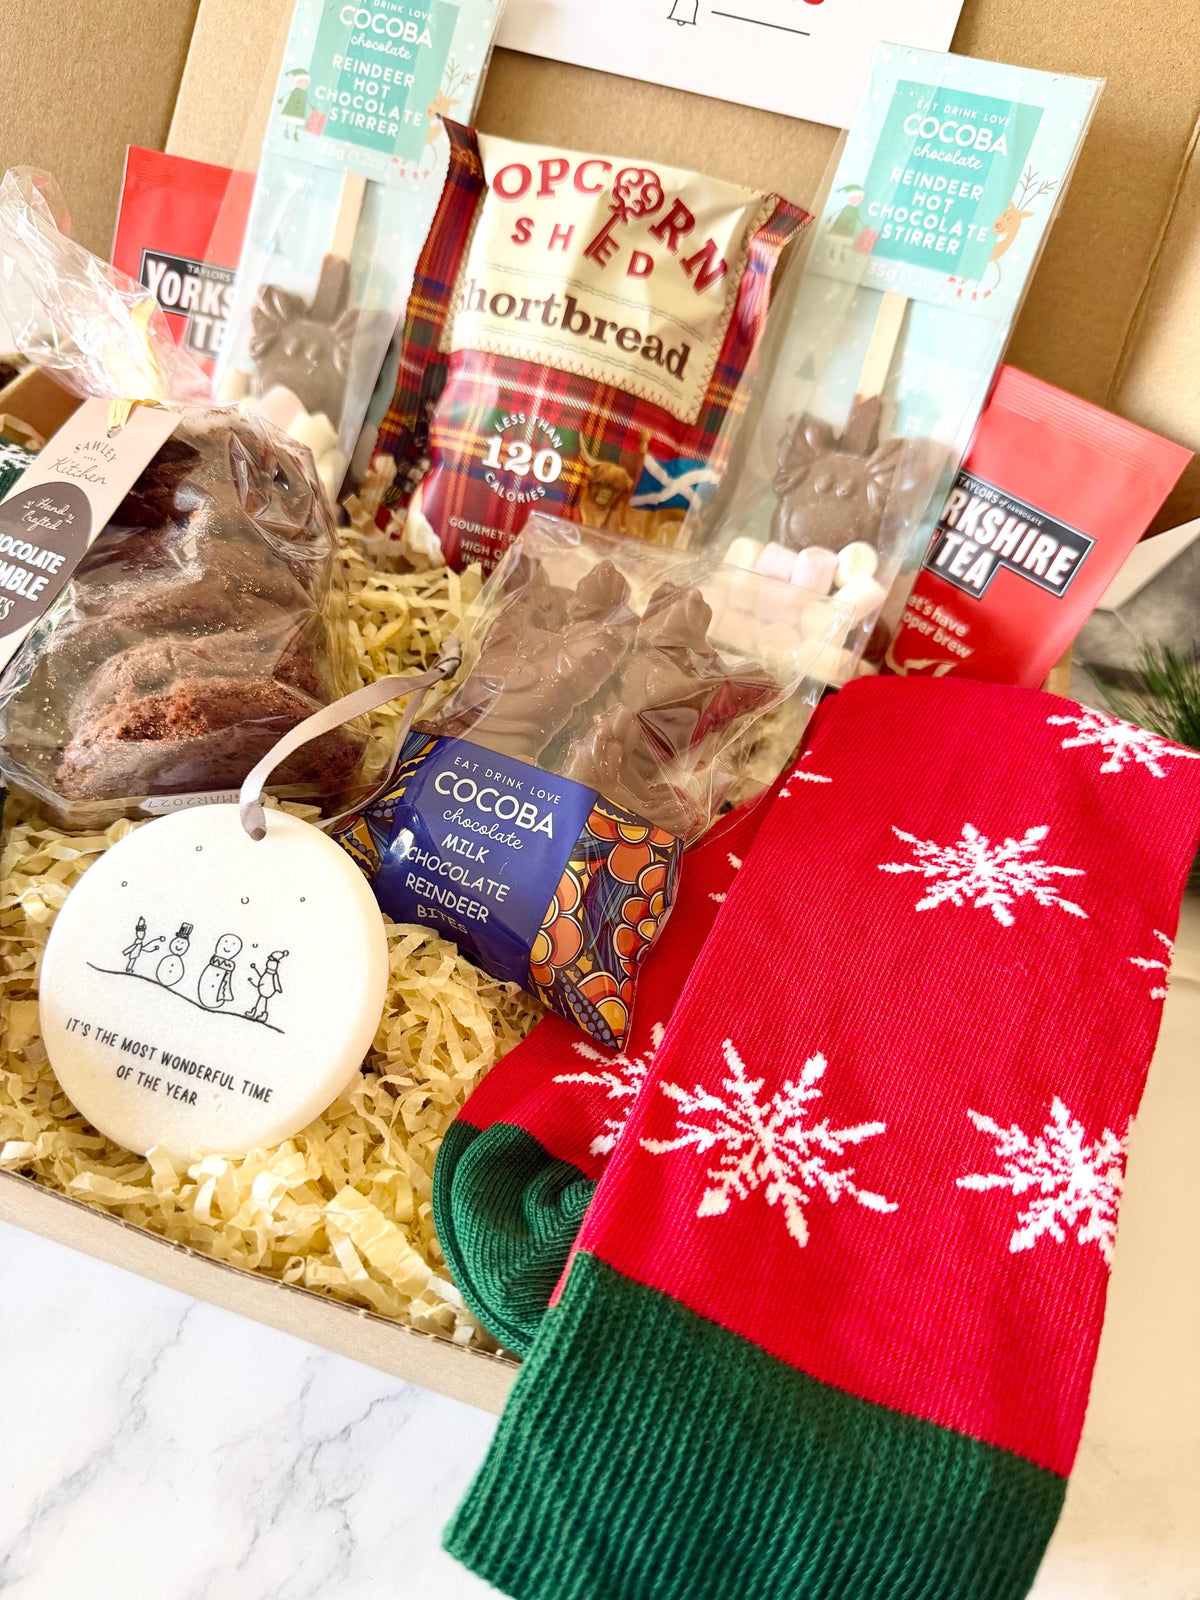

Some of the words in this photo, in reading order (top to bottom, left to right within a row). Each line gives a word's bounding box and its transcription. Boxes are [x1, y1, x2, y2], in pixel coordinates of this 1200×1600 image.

[373, 0, 404, 13] DRINK
[339, 5, 433, 48] COCOBA
[350, 33, 412, 60] chocolate
[332, 54, 415, 88] REINDEER
[353, 78, 391, 99] HOT
[314, 85, 424, 127] CHOCOLATE
[916, 99, 938, 112] EAT
[943, 104, 977, 120] DRINK
[983, 113, 1012, 127] LOVE
[329, 107, 400, 138] STIRRER
[903, 114, 1009, 156] COCOBA
[913, 142, 983, 171] chocolate
[890, 167, 984, 201] REINDEER
[911, 192, 955, 215] HOT
[867, 201, 990, 243] CHOCOLATE
[510, 216, 655, 280] SHED
[881, 224, 960, 255] STIRRER
[186, 263, 231, 282] TAYLORS
[494, 411, 526, 433] LESS
[530, 414, 563, 449] THAN
[73, 440, 117, 463] SAWLEY
[481, 434, 563, 483] 120
[48, 456, 108, 486] Kitchen
[484, 471, 546, 504] CALORIES
[958, 476, 1000, 504] TAYLORS
[22, 510, 63, 532] Crafted
[36, 497, 70, 516] Hand
[449, 516, 505, 541] GOURMET
[461, 539, 491, 556] HIGH
[935, 529, 996, 590] TEA
[931, 600, 969, 637] have
[932, 628, 975, 660] brew
[453, 756, 480, 774] EAT
[484, 768, 524, 791] DRINK
[530, 785, 562, 805] LOVE
[434, 771, 554, 839] COCOBA
[442, 807, 524, 850] chocolate
[441, 833, 490, 864] MILK
[407, 846, 511, 902] CHOCOLATE
[405, 872, 490, 924] REINDEER
[416, 903, 469, 935] BITES
[65, 1017, 91, 1037] IT'S
[95, 1027, 119, 1047] THE
[120, 1037, 158, 1061] MOST
[160, 1050, 235, 1091] WONDERFUL
[242, 1079, 274, 1104] TIME
[116, 1064, 134, 1080] OF
[137, 1071, 162, 1092] THE
[166, 1082, 199, 1106] YEAR
